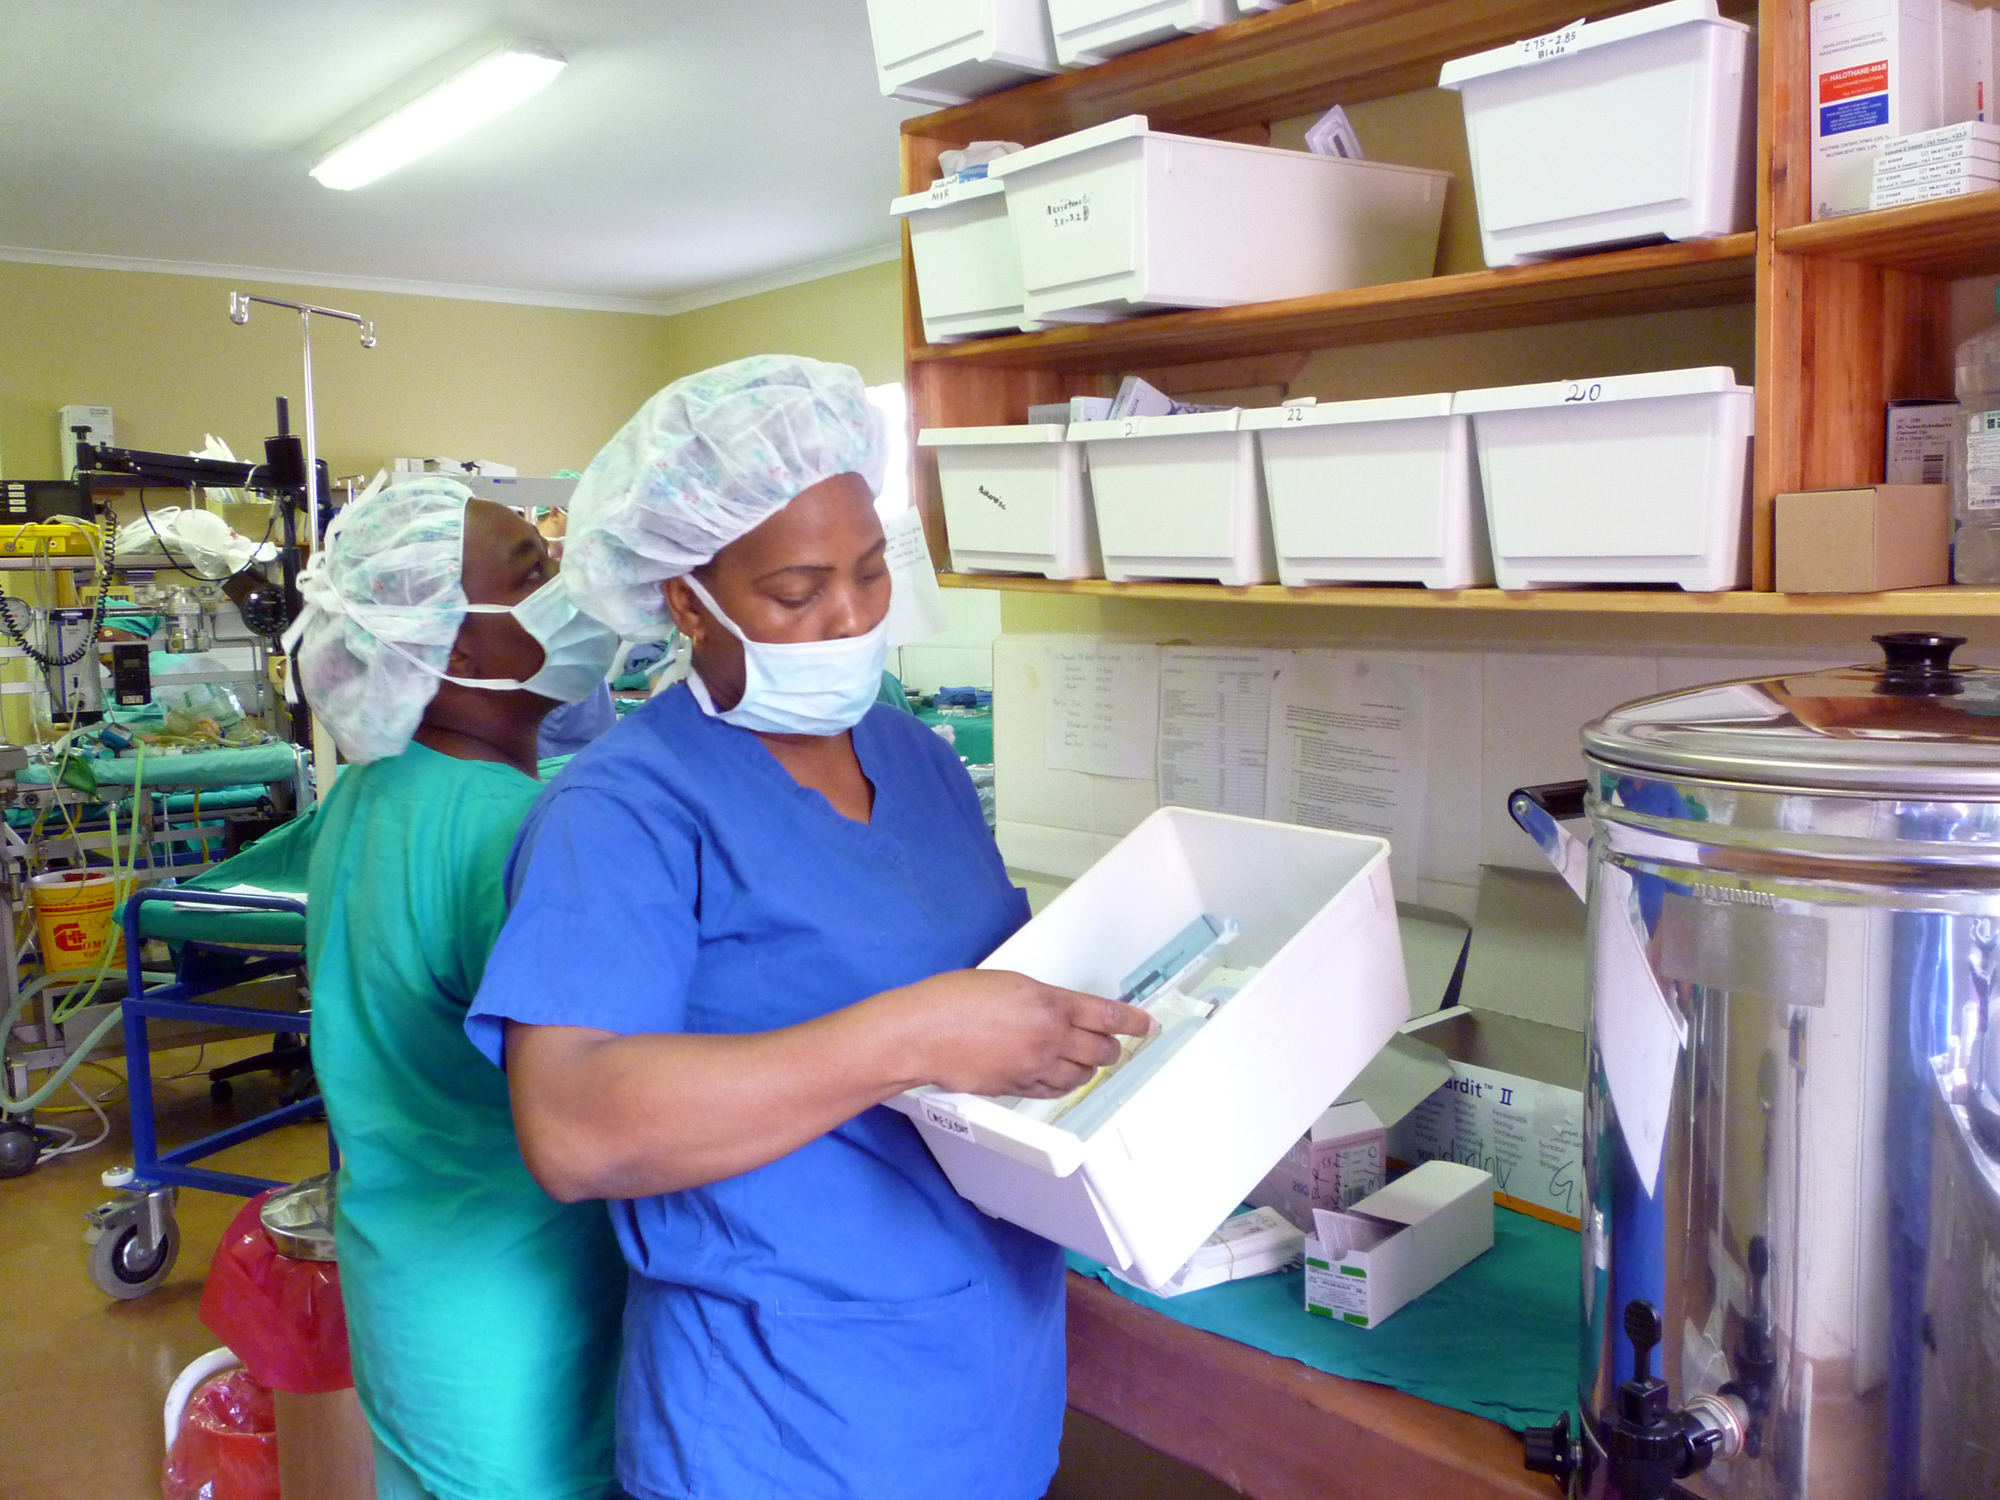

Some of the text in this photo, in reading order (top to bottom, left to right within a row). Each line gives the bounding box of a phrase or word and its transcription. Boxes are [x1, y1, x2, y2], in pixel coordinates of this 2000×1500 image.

[1829, 63, 1888, 82] HALOTHANE-M&B
[1952, 131, 1968, 139] +23.0
[1565, 384, 1602, 402] 20
[1287, 408, 1304, 422] 22
